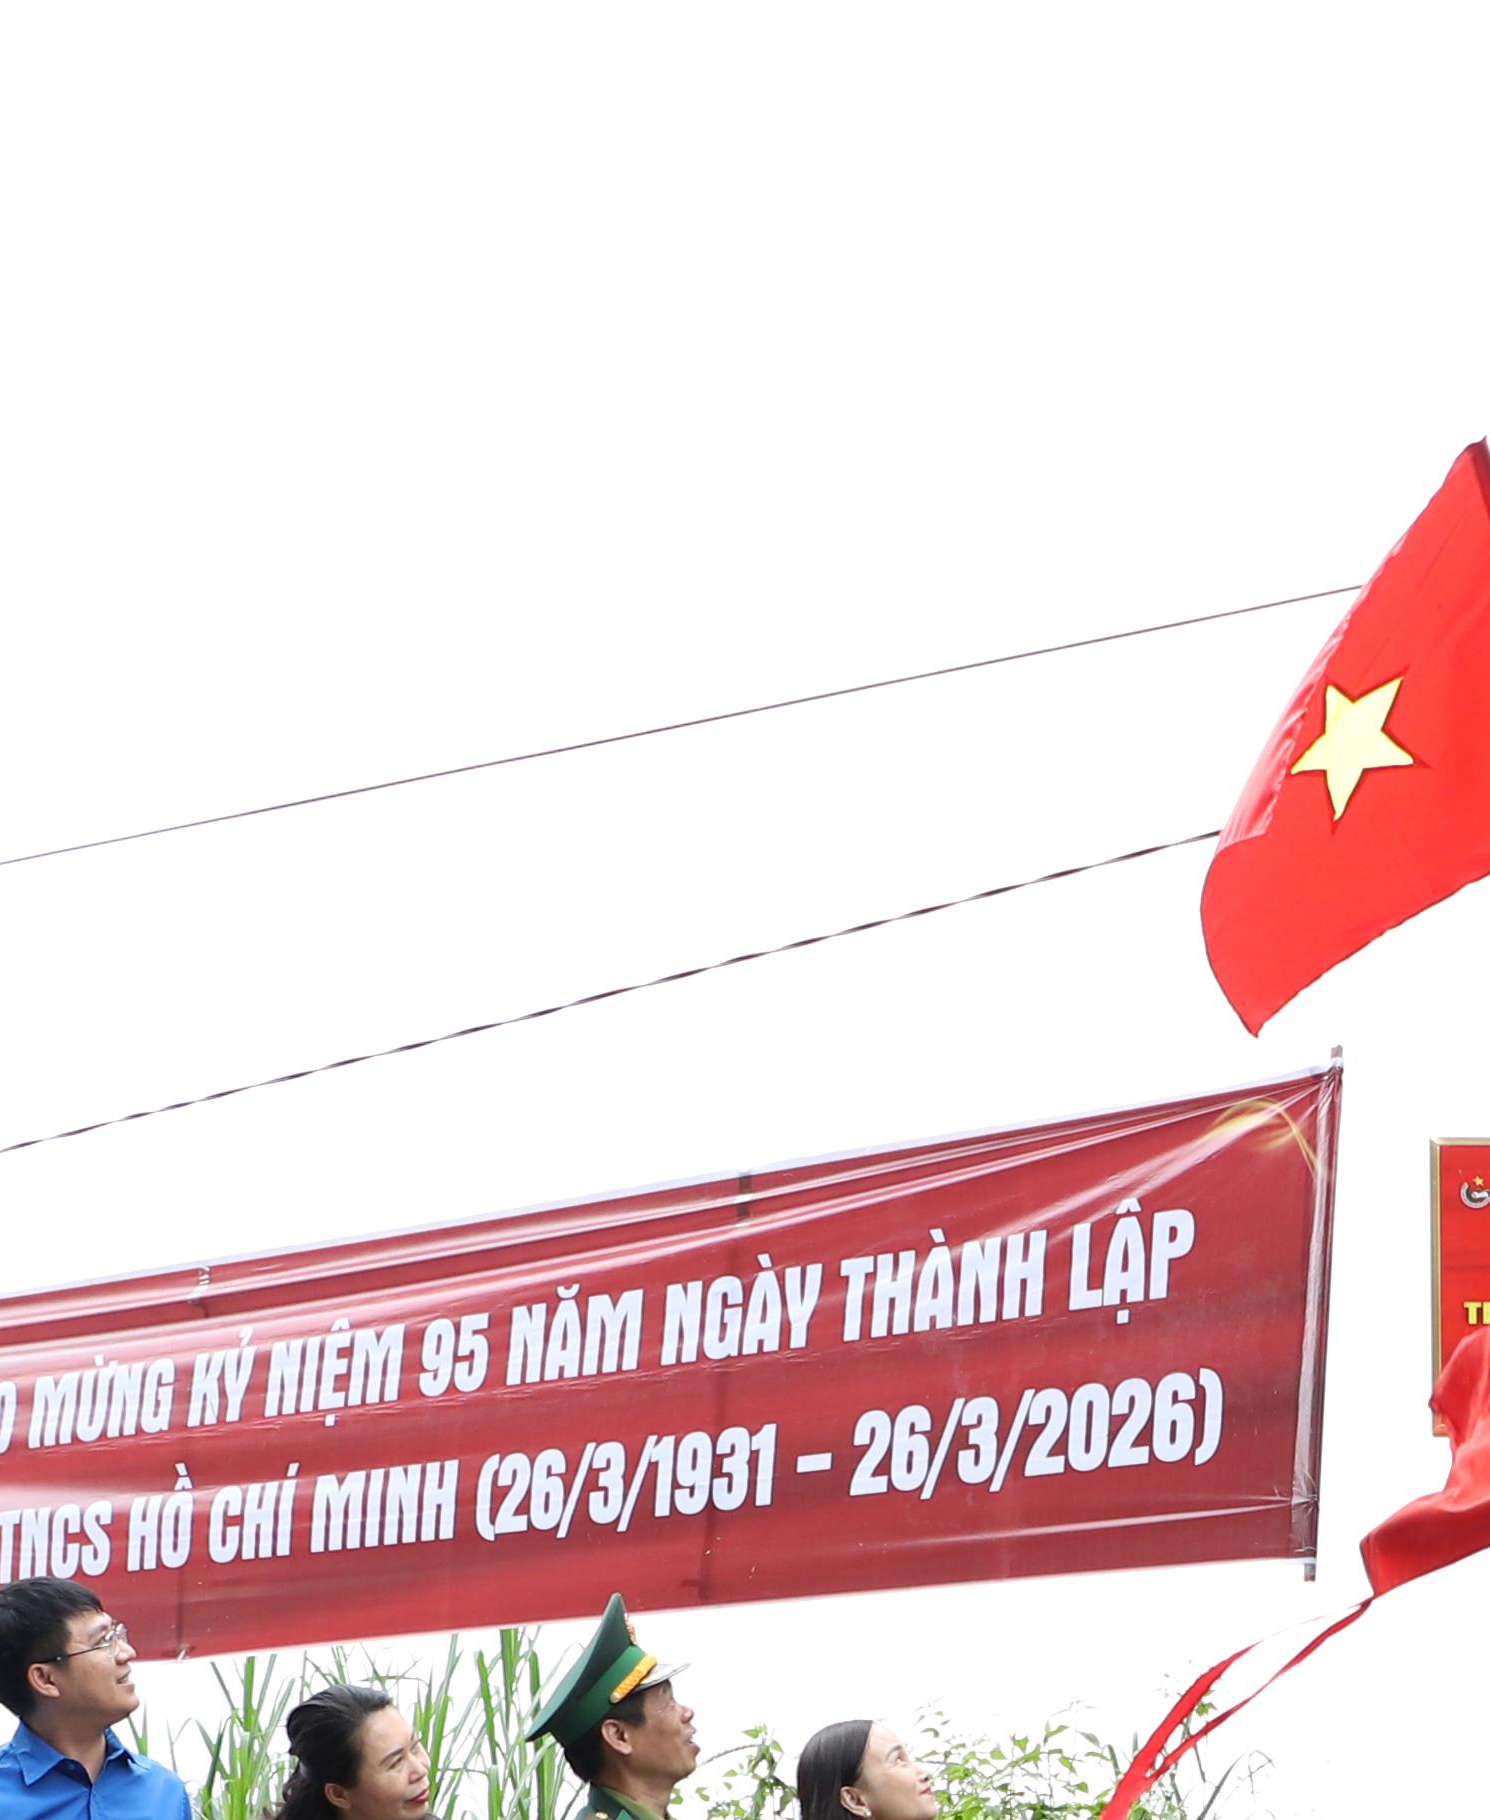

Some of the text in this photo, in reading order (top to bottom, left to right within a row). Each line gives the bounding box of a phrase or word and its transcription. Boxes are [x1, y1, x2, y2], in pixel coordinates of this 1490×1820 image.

[27, 1354, 177, 1449] MỪNG
[186, 1325, 258, 1428] KỶ
[264, 1317, 407, 1427] NIỆM
[418, 1312, 490, 1397] 95
[505, 1282, 644, 1387] NĂM
[660, 1253, 823, 1365] NGÀY
[840, 1227, 1048, 1343] THÀNH
[1069, 1197, 1197, 1325] LẬP
[126, 1462, 194, 1572] HỒ
[208, 1462, 300, 1565] CHÍ
[310, 1459, 460, 1554] MINH
[475, 1422, 778, 1543] (26/3/1931
[849, 1367, 1224, 1500] 26/3/2026)
